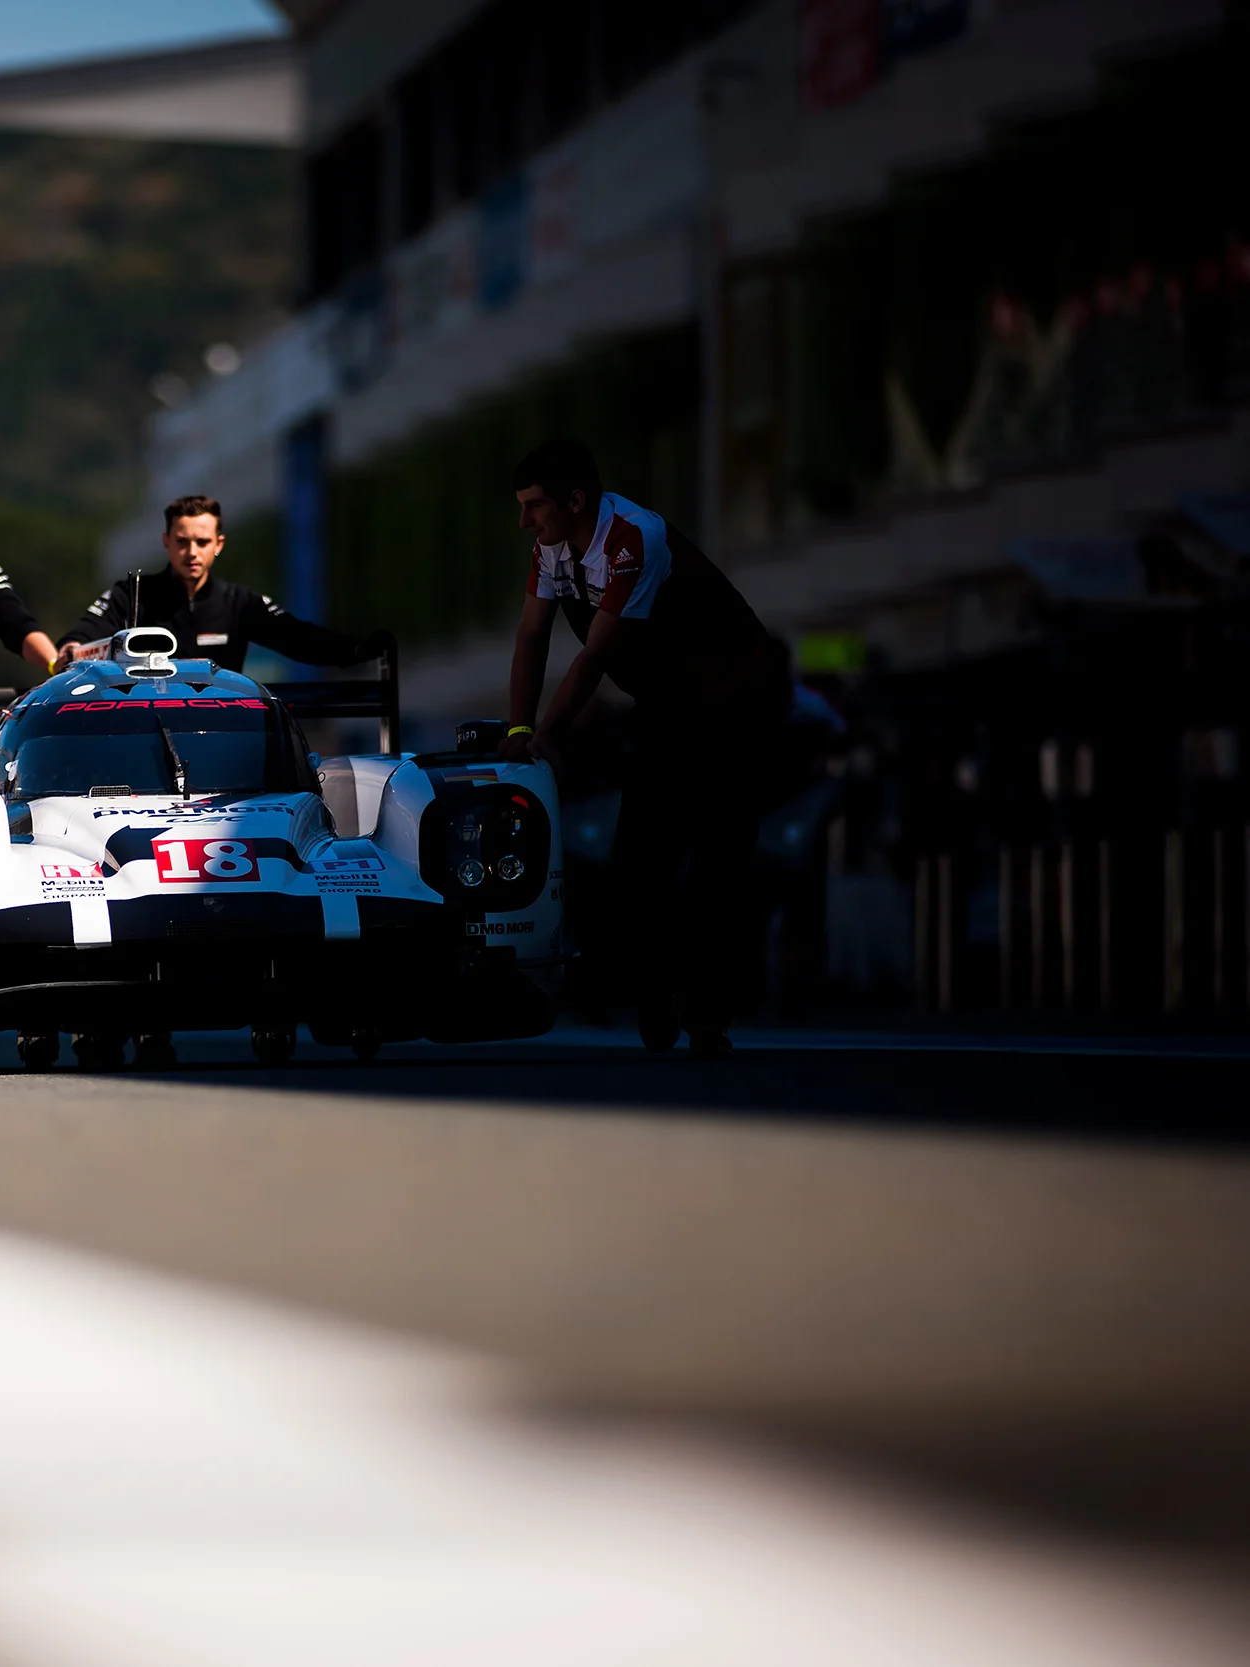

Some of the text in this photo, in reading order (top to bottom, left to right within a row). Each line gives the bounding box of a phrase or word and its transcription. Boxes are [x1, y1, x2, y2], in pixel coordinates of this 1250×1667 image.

[56, 699, 269, 714] PORSCHE
[157, 840, 253, 879] 18
[322, 860, 371, 871] P1
[467, 921, 535, 935] DMG MORI
